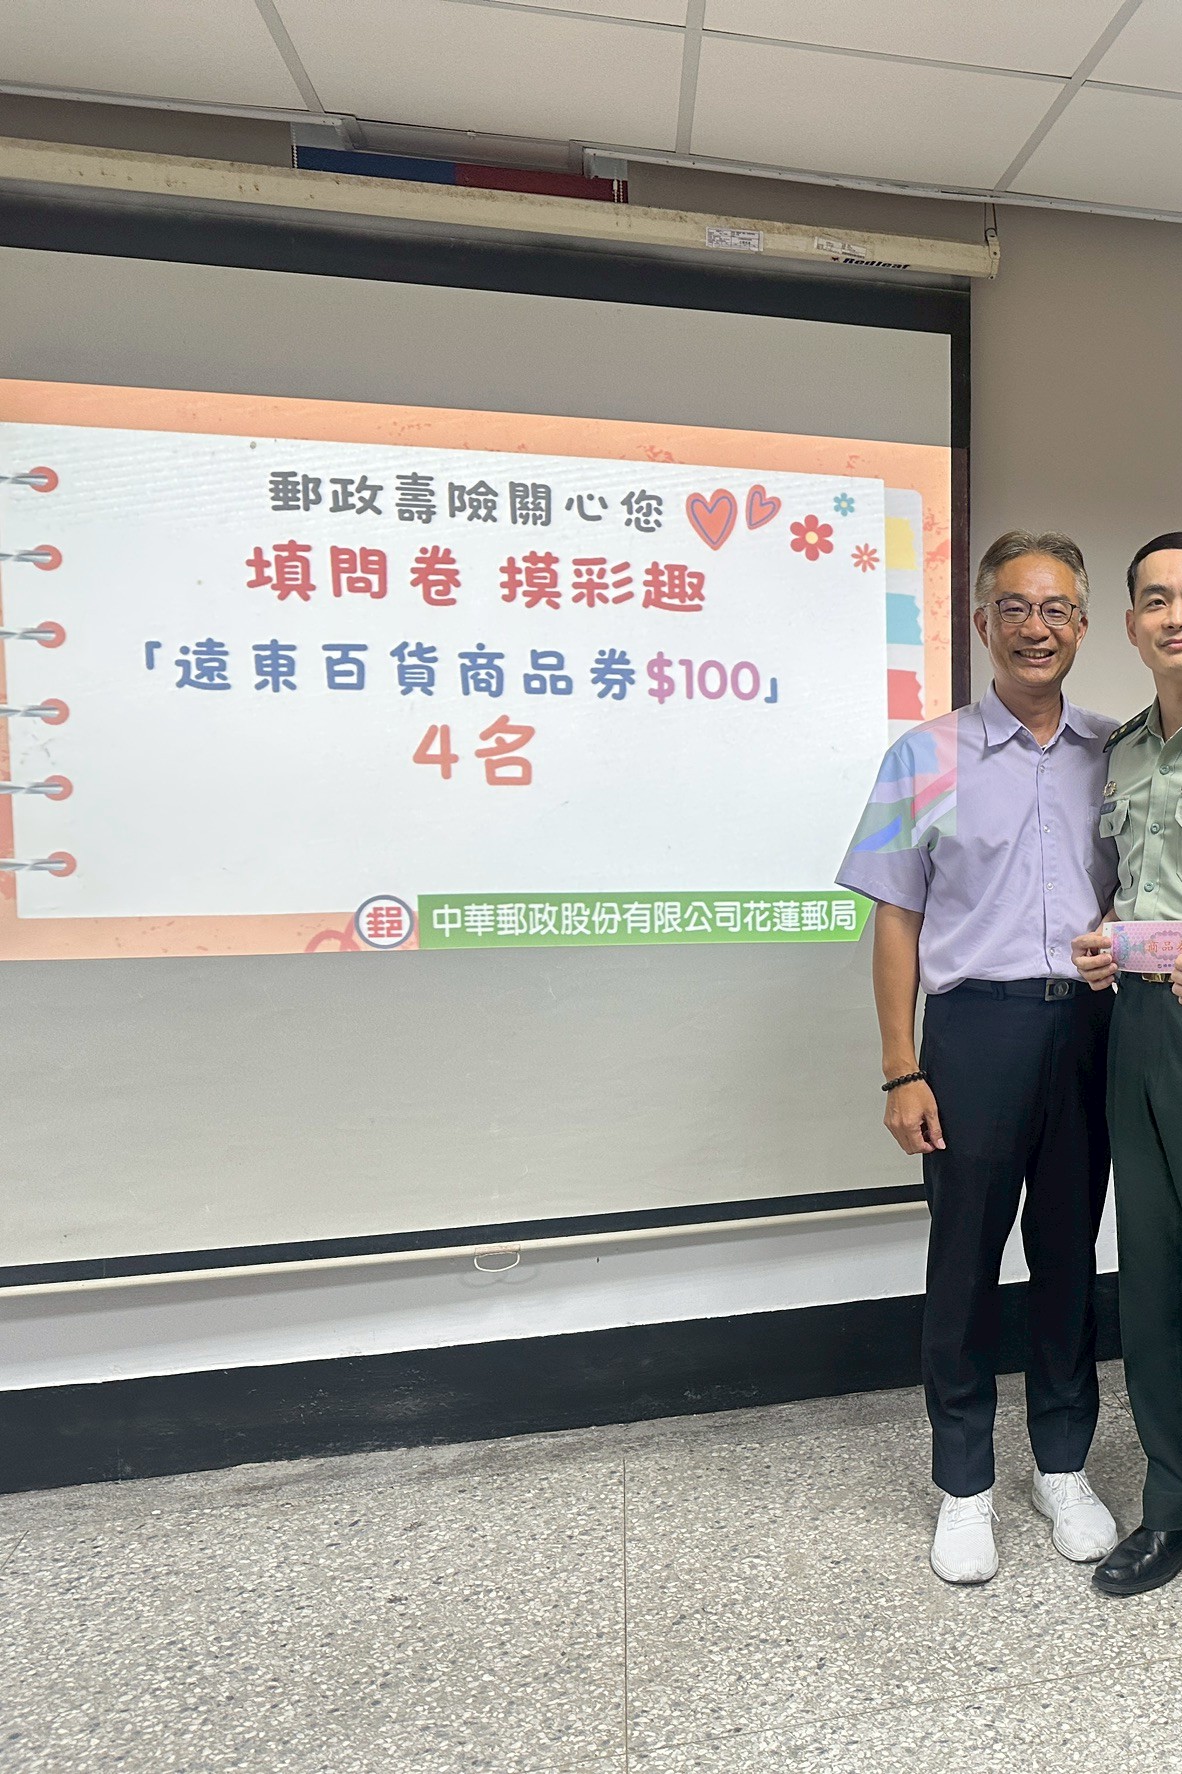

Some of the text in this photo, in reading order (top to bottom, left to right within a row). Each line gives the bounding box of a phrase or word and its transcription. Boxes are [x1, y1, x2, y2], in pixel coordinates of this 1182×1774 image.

[268, 471, 664, 533] 郵政壽險關心您
[246, 540, 706, 612] 填問卷 摸彩趣
[144, 638, 779, 704] 「遠東百貨商品券$100」
[412, 715, 536, 787] 4名
[431, 899, 858, 937] 中華郵政股份有限公司花蓮郵局
